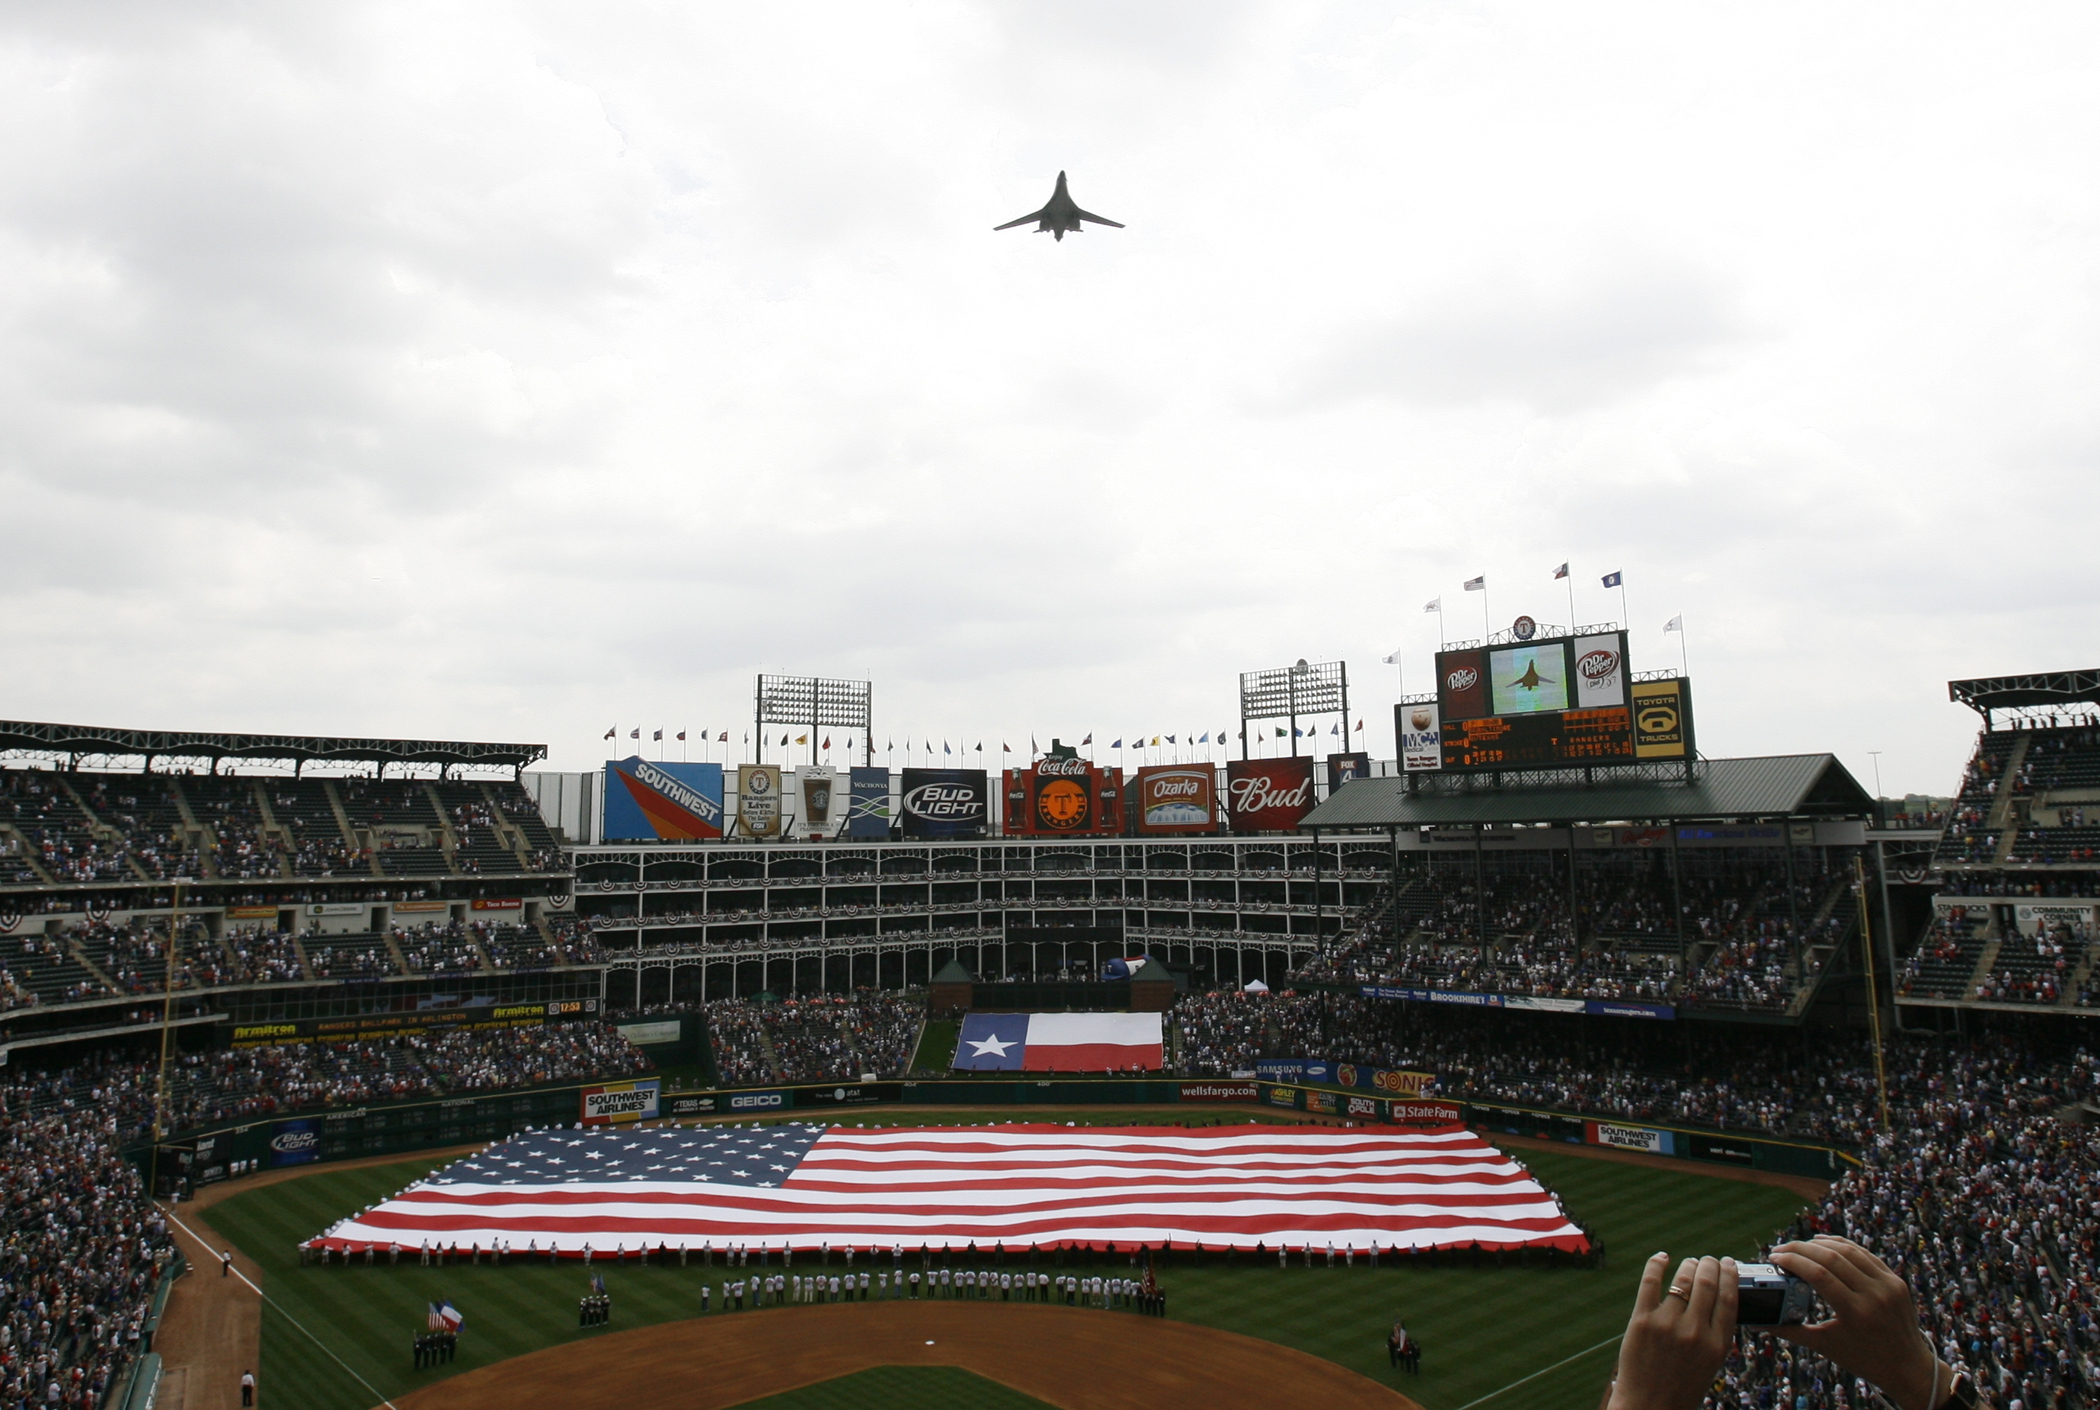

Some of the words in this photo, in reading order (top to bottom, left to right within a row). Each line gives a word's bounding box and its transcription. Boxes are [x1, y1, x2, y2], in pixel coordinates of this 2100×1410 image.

[1592, 654, 1604, 664] Dr
[1584, 656, 1612, 676] Pepper
[1458, 670, 1468, 678] Dr
[1450, 671, 1475, 690] Pepper
[1636, 697, 1676, 706] TOYOTA
[1570, 735, 1610, 743] RANGERS
[1640, 734, 1678, 742] TRUCKS
[1038, 758, 1087, 776] Coca-Cola
[756, 777, 764, 788] T
[1154, 779, 1198, 798] Ozarka
[635, 764, 718, 821] SOUTHWEST
[922, 788, 974, 801] BUD
[1230, 776, 1311, 813] Bud
[912, 801, 983, 814] LIGHT
[1054, 794, 1072, 816] T
[2032, 906, 2091, 914] COMMUNITY
[1430, 992, 1485, 1004] BROOKSHIRE'S
[493, 1006, 544, 1018] Armitron
[560, 1002, 580, 1011] 12:53
[318, 1022, 356, 1030] RANGERS
[360, 1018, 402, 1027] BALLPARK
[422, 1014, 466, 1022] ARLINGTON
[234, 1024, 296, 1038] Armitron
[358, 1030, 396, 1040] Armitron
[510, 1018, 544, 1028] Armitron
[1256, 1065, 1302, 1074] SAMSUNG
[1376, 1070, 1434, 1092] SONIC
[588, 1090, 654, 1106] SOUTHWEST
[1182, 1086, 1257, 1098] wellsfargo.com
[1274, 1088, 1296, 1097] ASHLEY
[441, 1100, 476, 1108] NATIONAL
[680, 1099, 698, 1108] TEXAS
[731, 1094, 782, 1107] GEICO
[1350, 1098, 1375, 1106] SOUTH
[596, 1101, 646, 1114] AIRLINES
[326, 1112, 366, 1120] AMERICAN
[283, 1132, 314, 1142] BUD
[1600, 1126, 1657, 1141] SOUTHWEST
[277, 1138, 319, 1150] LIGHT
[1608, 1136, 1650, 1148] AIRLINES
